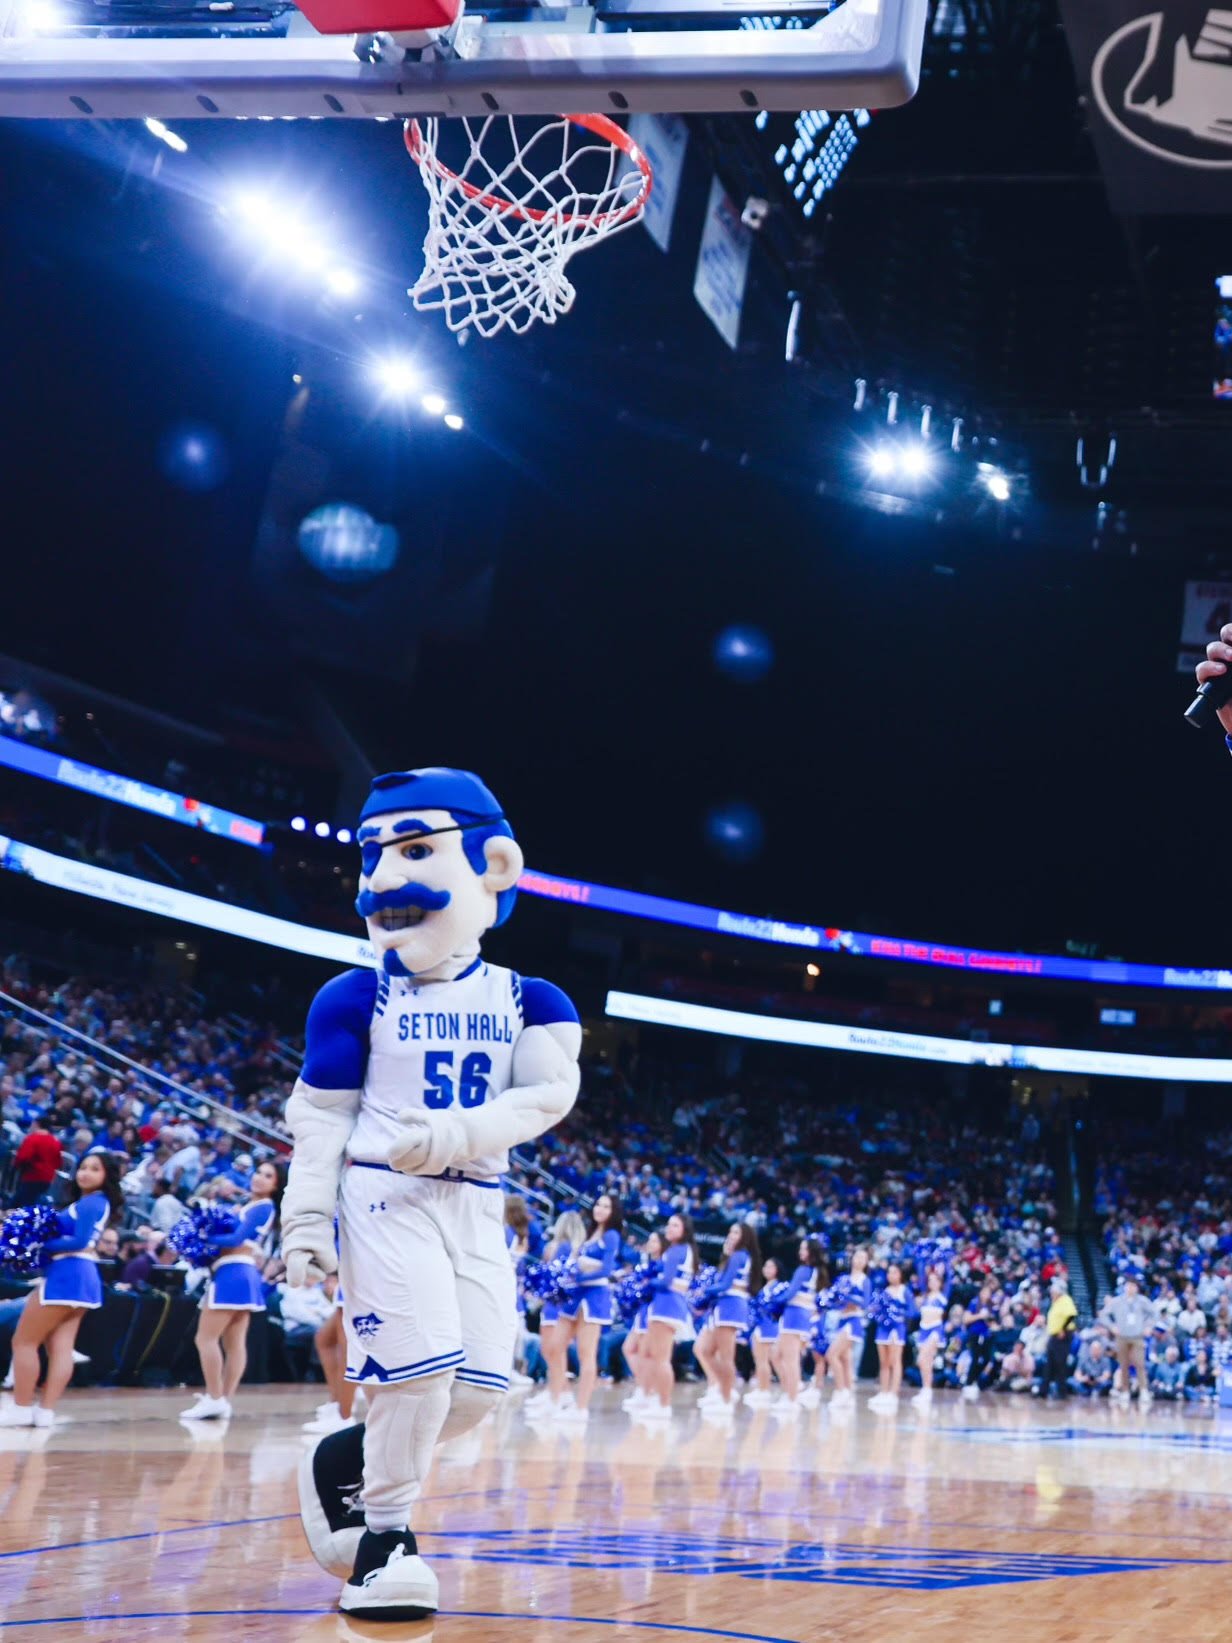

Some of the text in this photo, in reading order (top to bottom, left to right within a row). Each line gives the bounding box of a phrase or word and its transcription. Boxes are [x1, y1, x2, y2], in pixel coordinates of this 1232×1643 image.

[398, 1013, 512, 1044] SETON HALL
[423, 1051, 492, 1110] 56
